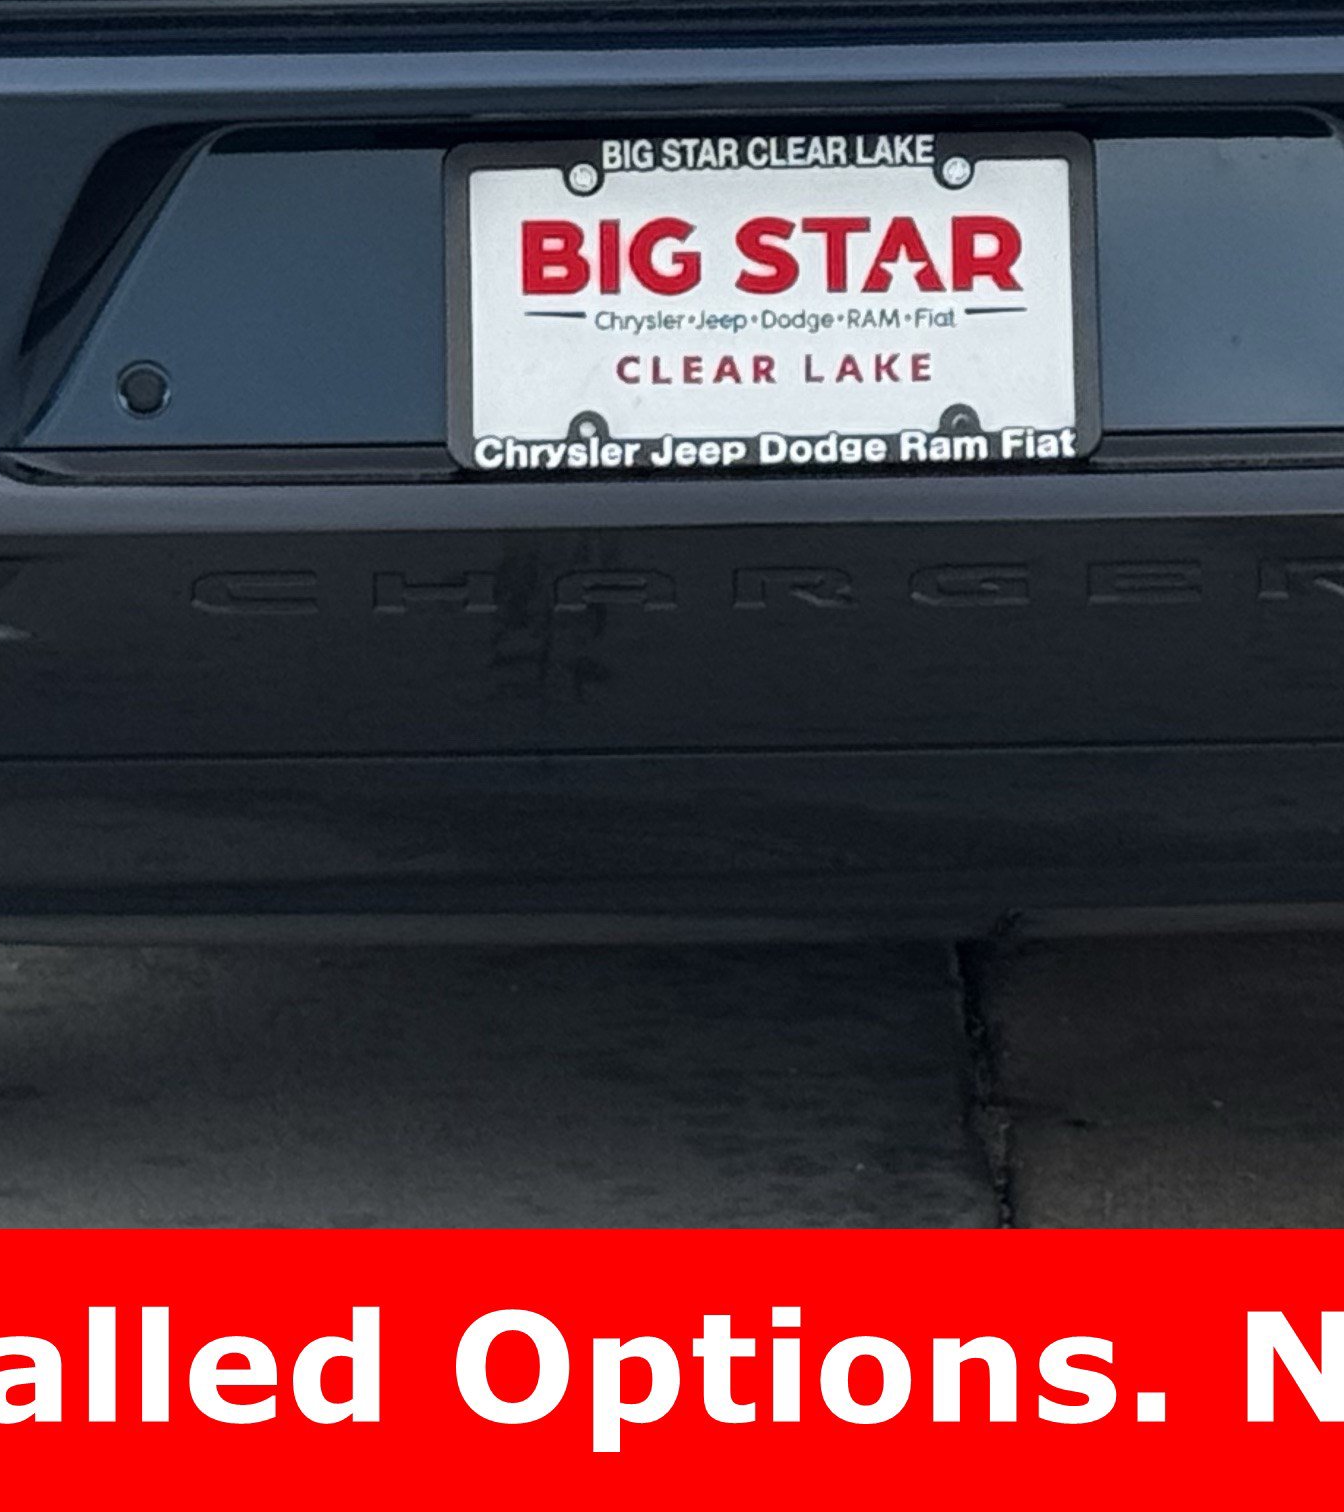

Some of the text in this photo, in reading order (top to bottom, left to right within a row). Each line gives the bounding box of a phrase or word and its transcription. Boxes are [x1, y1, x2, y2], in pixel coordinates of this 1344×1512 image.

[602, 135, 935, 170] BIG STAR CLEAR LAKE
[520, 215, 1024, 296] BIG STAR
[616, 352, 932, 385] CLEAR LAKE
[473, 428, 1077, 469] Chrysler Jeep Dodge Ram Fiat
